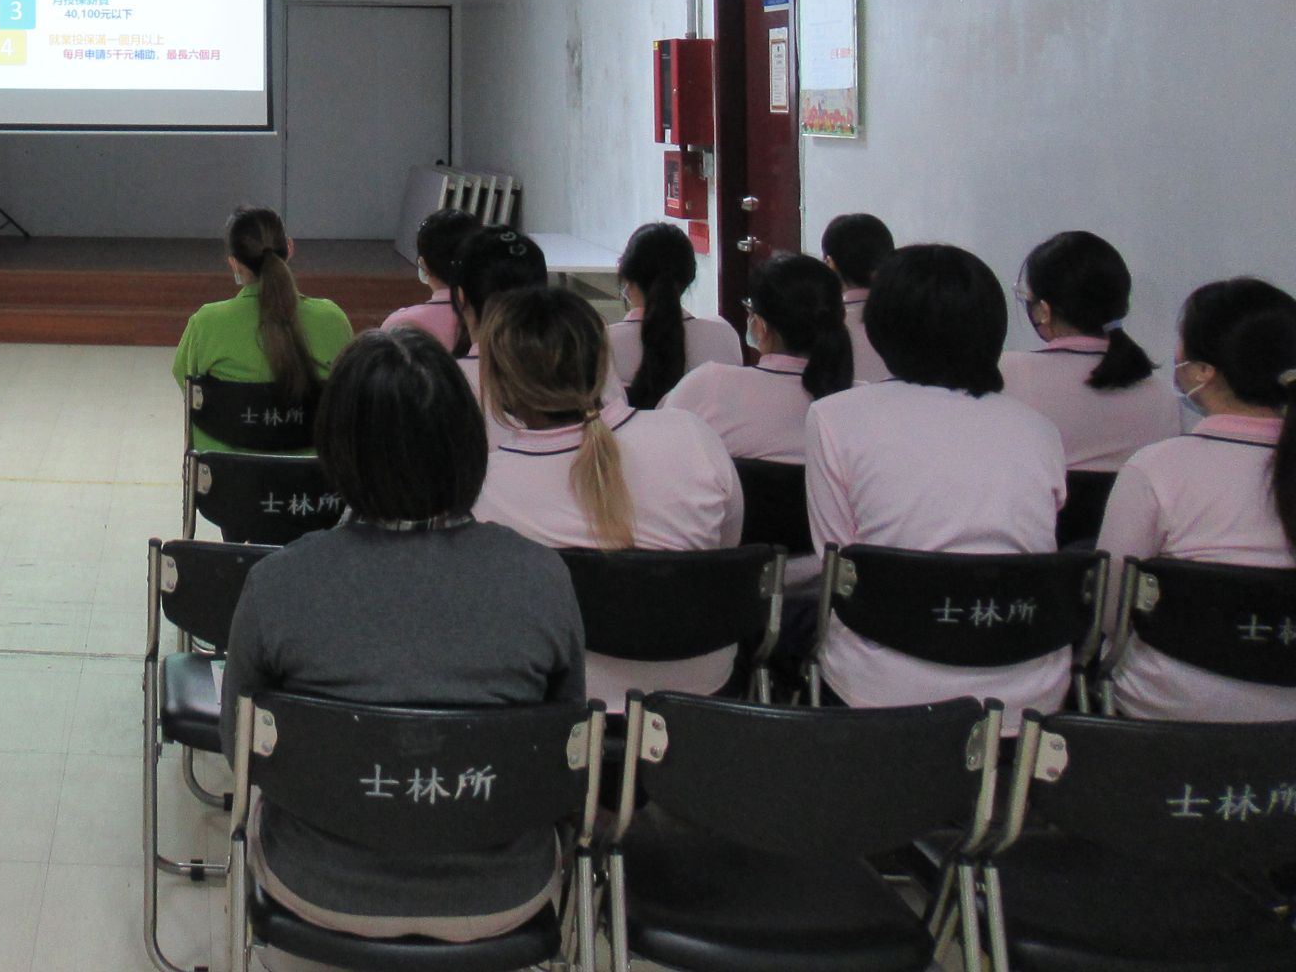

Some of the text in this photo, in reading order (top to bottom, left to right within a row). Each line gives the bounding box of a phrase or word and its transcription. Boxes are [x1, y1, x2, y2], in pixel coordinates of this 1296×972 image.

[9, 0, 23, 21] 3
[64, 8, 133, 20] 40,100元以下
[0, 37, 14, 57] 4
[240, 407, 305, 426] 士林所
[260, 491, 343, 516] 士林所
[932, 597, 1038, 627] 士林所
[360, 763, 497, 805] 士林所
